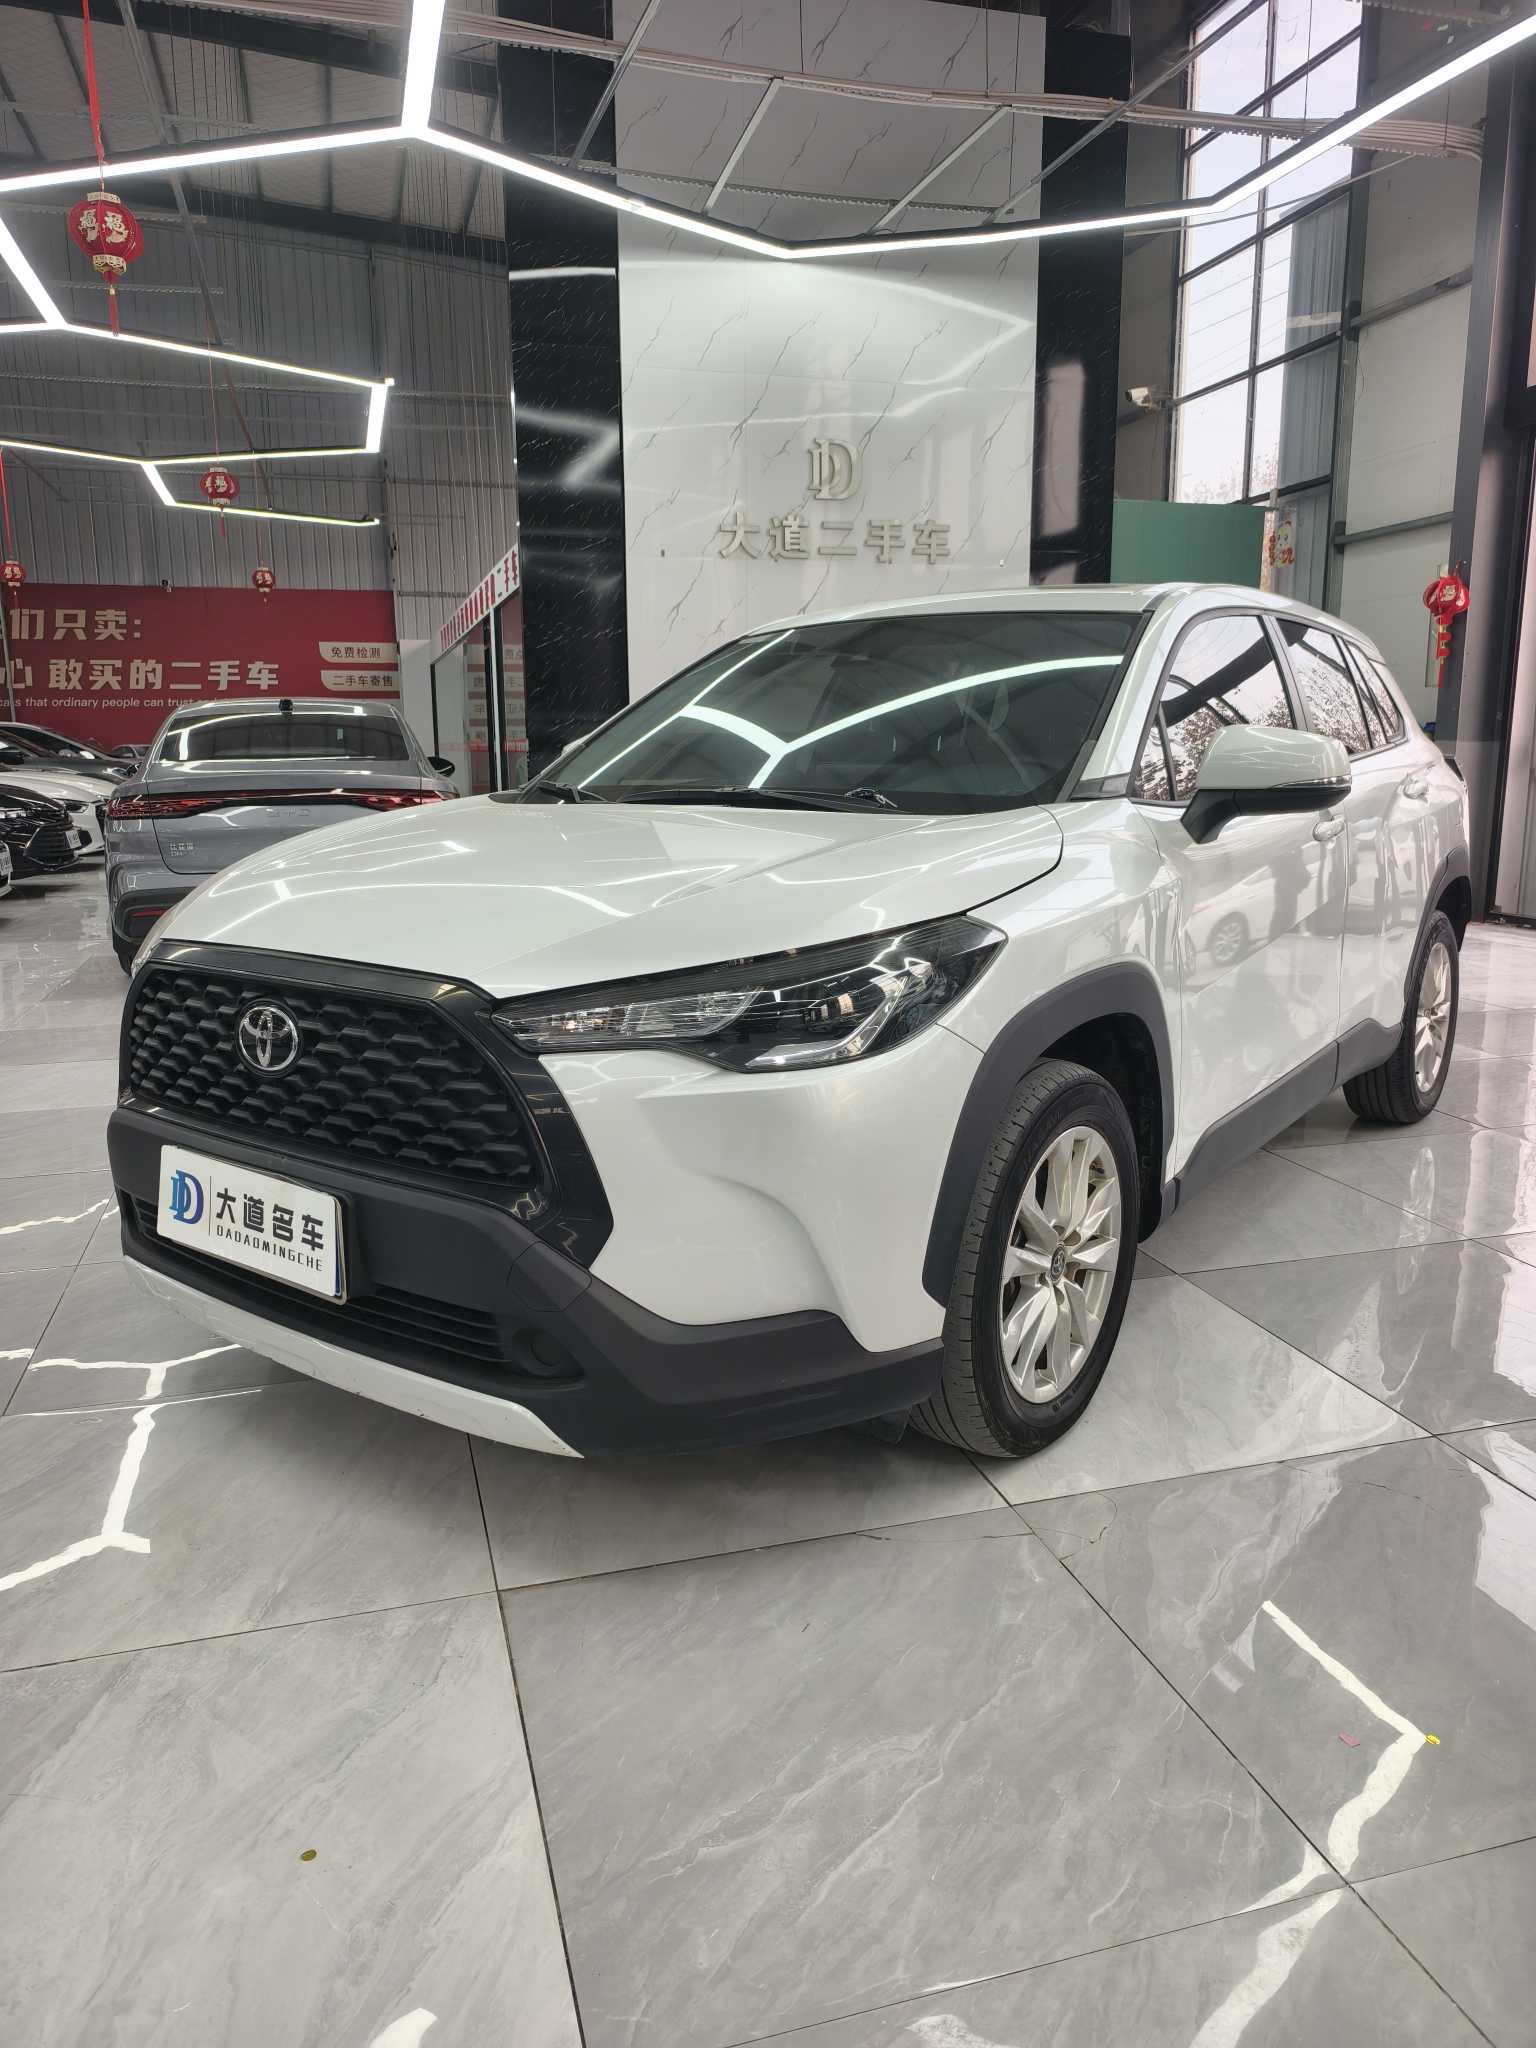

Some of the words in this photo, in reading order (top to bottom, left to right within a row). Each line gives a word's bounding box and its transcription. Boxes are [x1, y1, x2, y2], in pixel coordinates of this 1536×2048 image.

[719, 511, 951, 565] 大道二手车
[331, 646, 381, 658] 免费检测
[48, 658, 279, 691] 敢买的二手车
[332, 674, 393, 687] 二手车寄售
[25, 697, 48, 707] that
[51, 696, 98, 709] ordinary
[102, 696, 140, 708] people
[143, 699, 163, 707] can
[215, 1187, 324, 1251] 大道名车
[216, 1224, 323, 1272] DADAOMINGCHE
